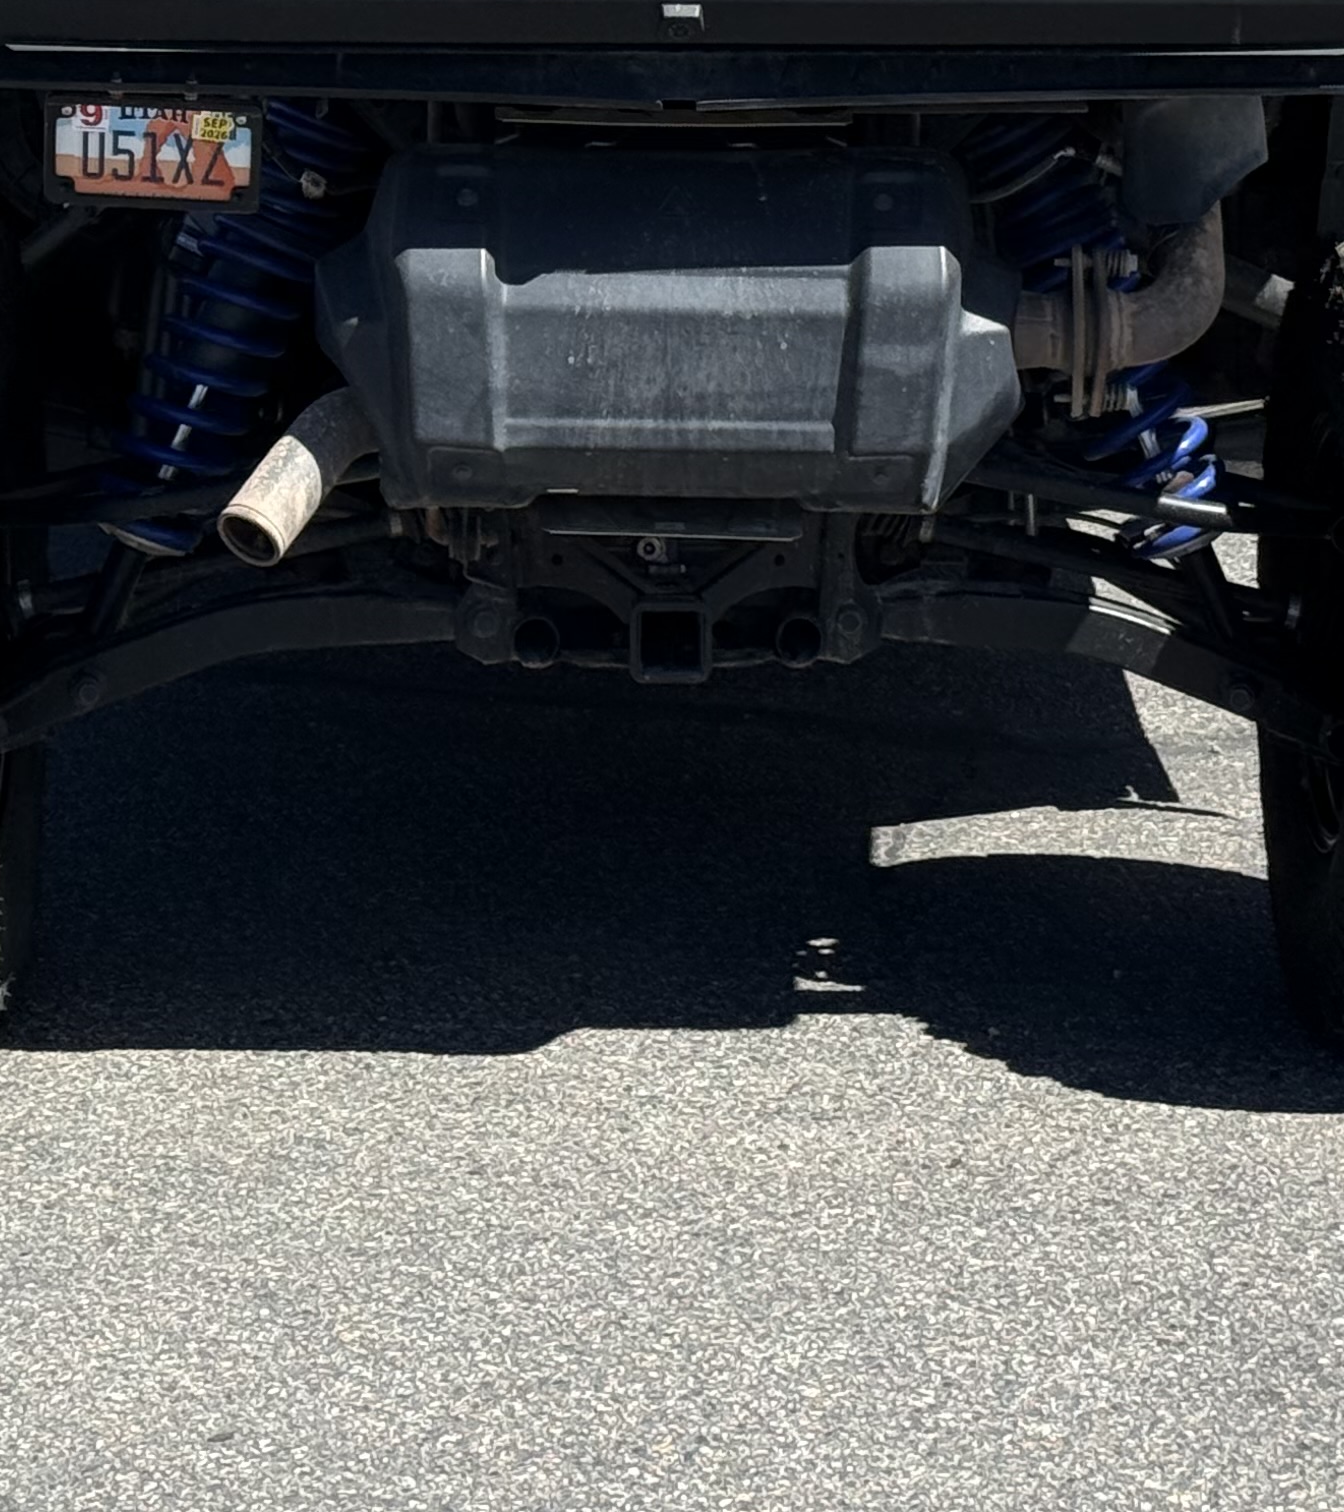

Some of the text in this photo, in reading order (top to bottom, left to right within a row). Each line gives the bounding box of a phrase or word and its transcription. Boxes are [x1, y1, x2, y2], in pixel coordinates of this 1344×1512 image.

[80, 104, 103, 126] 9
[203, 117, 228, 129] SEP
[201, 129, 228, 140] 2026
